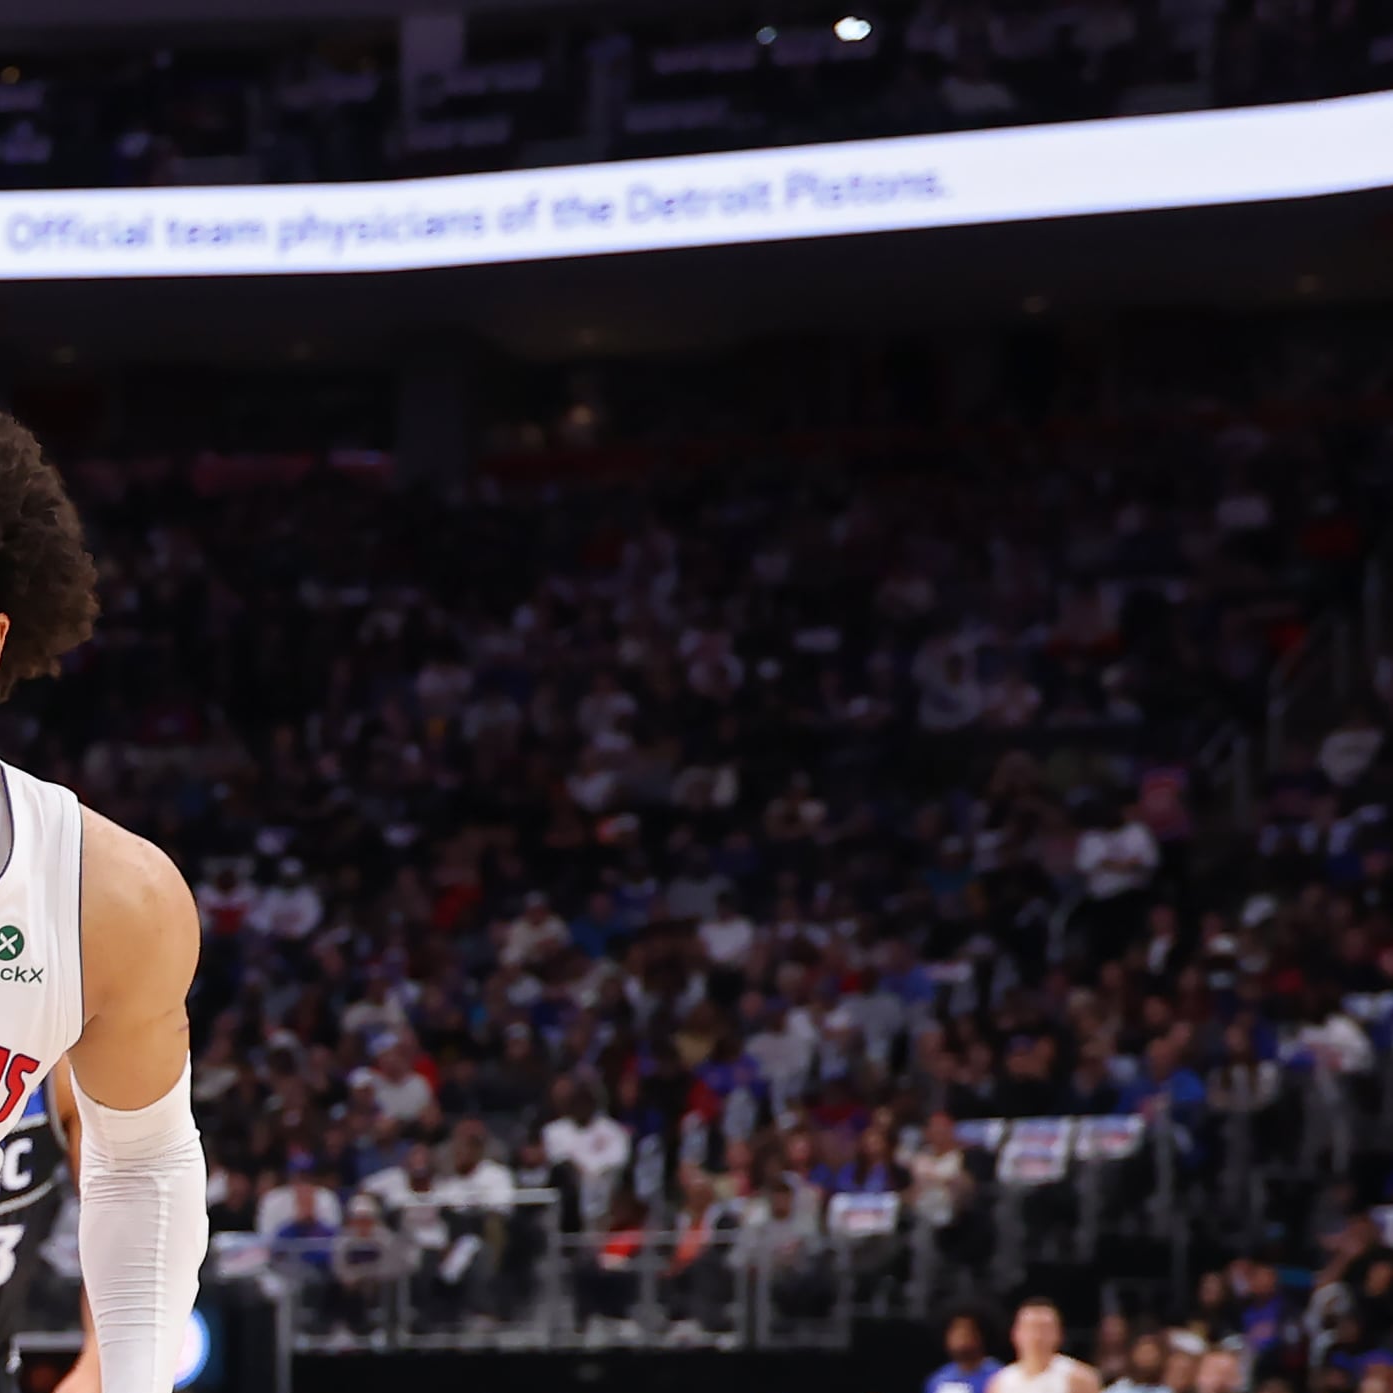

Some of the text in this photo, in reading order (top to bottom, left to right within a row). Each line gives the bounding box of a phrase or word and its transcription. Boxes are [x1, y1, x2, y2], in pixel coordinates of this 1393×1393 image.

[7, 208, 155, 255] Official
[167, 213, 268, 250] team
[278, 203, 485, 262] physicians
[497, 191, 540, 234] of
[552, 190, 615, 230] the
[626, 180, 772, 225] Detroit
